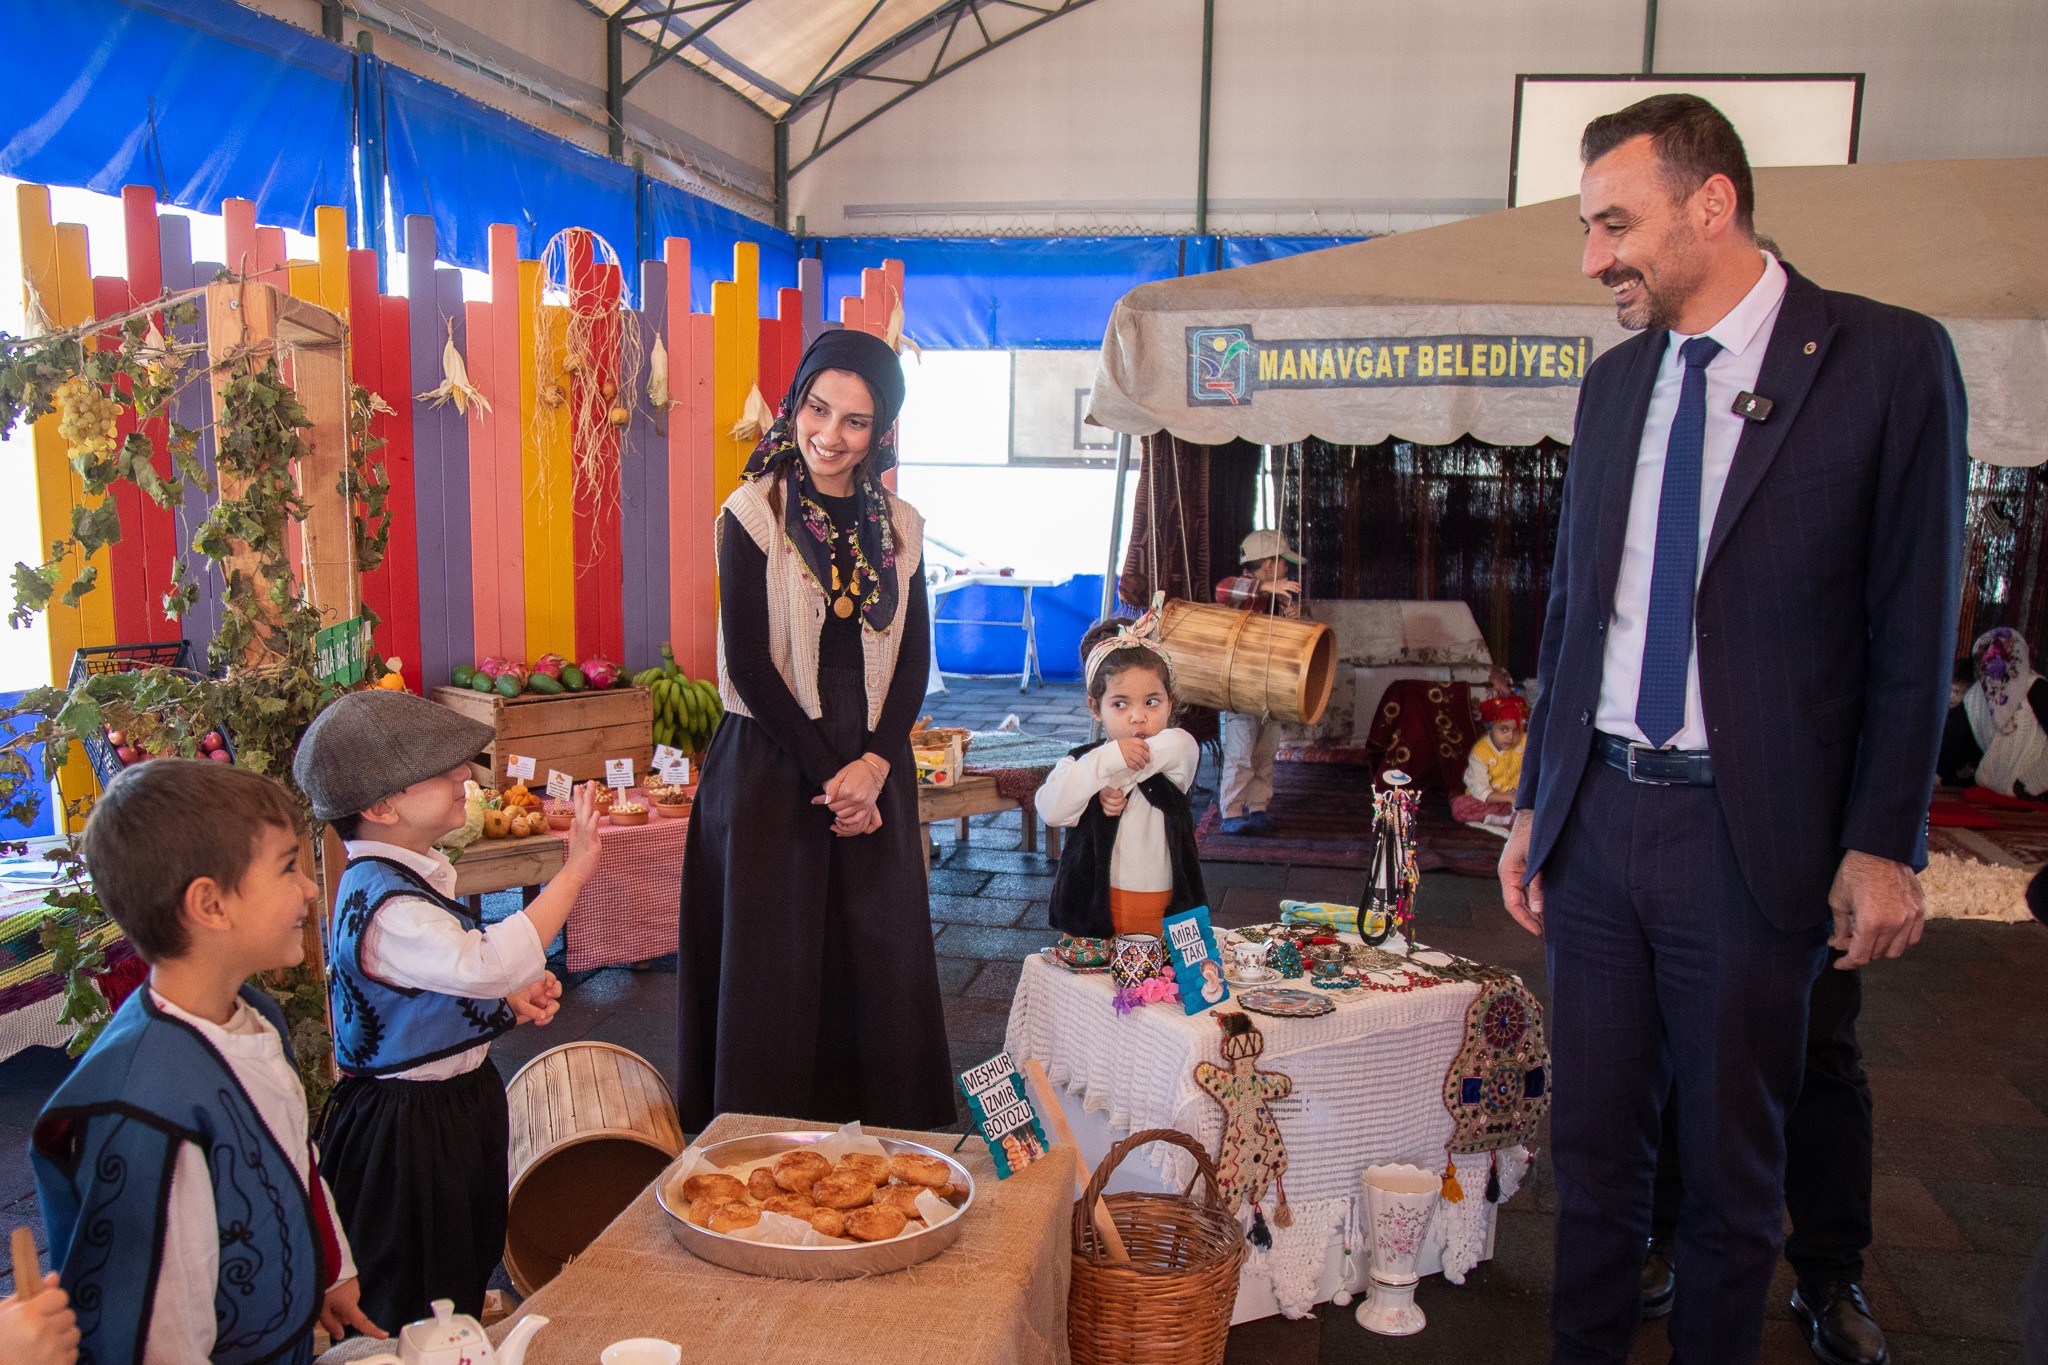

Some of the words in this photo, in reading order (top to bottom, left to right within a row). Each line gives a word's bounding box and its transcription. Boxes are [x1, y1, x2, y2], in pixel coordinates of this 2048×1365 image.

[1259, 346, 1410, 381] MANAVGAT
[1418, 336, 1586, 378] BELEDİYESİ
[1171, 924, 1200, 946] MİRA
[1182, 944, 1206, 963] TAKI
[963, 1054, 1013, 1092] MEŞHUR
[980, 1084, 1017, 1115] İZMİR
[983, 1101, 1031, 1142] BOYOZU
